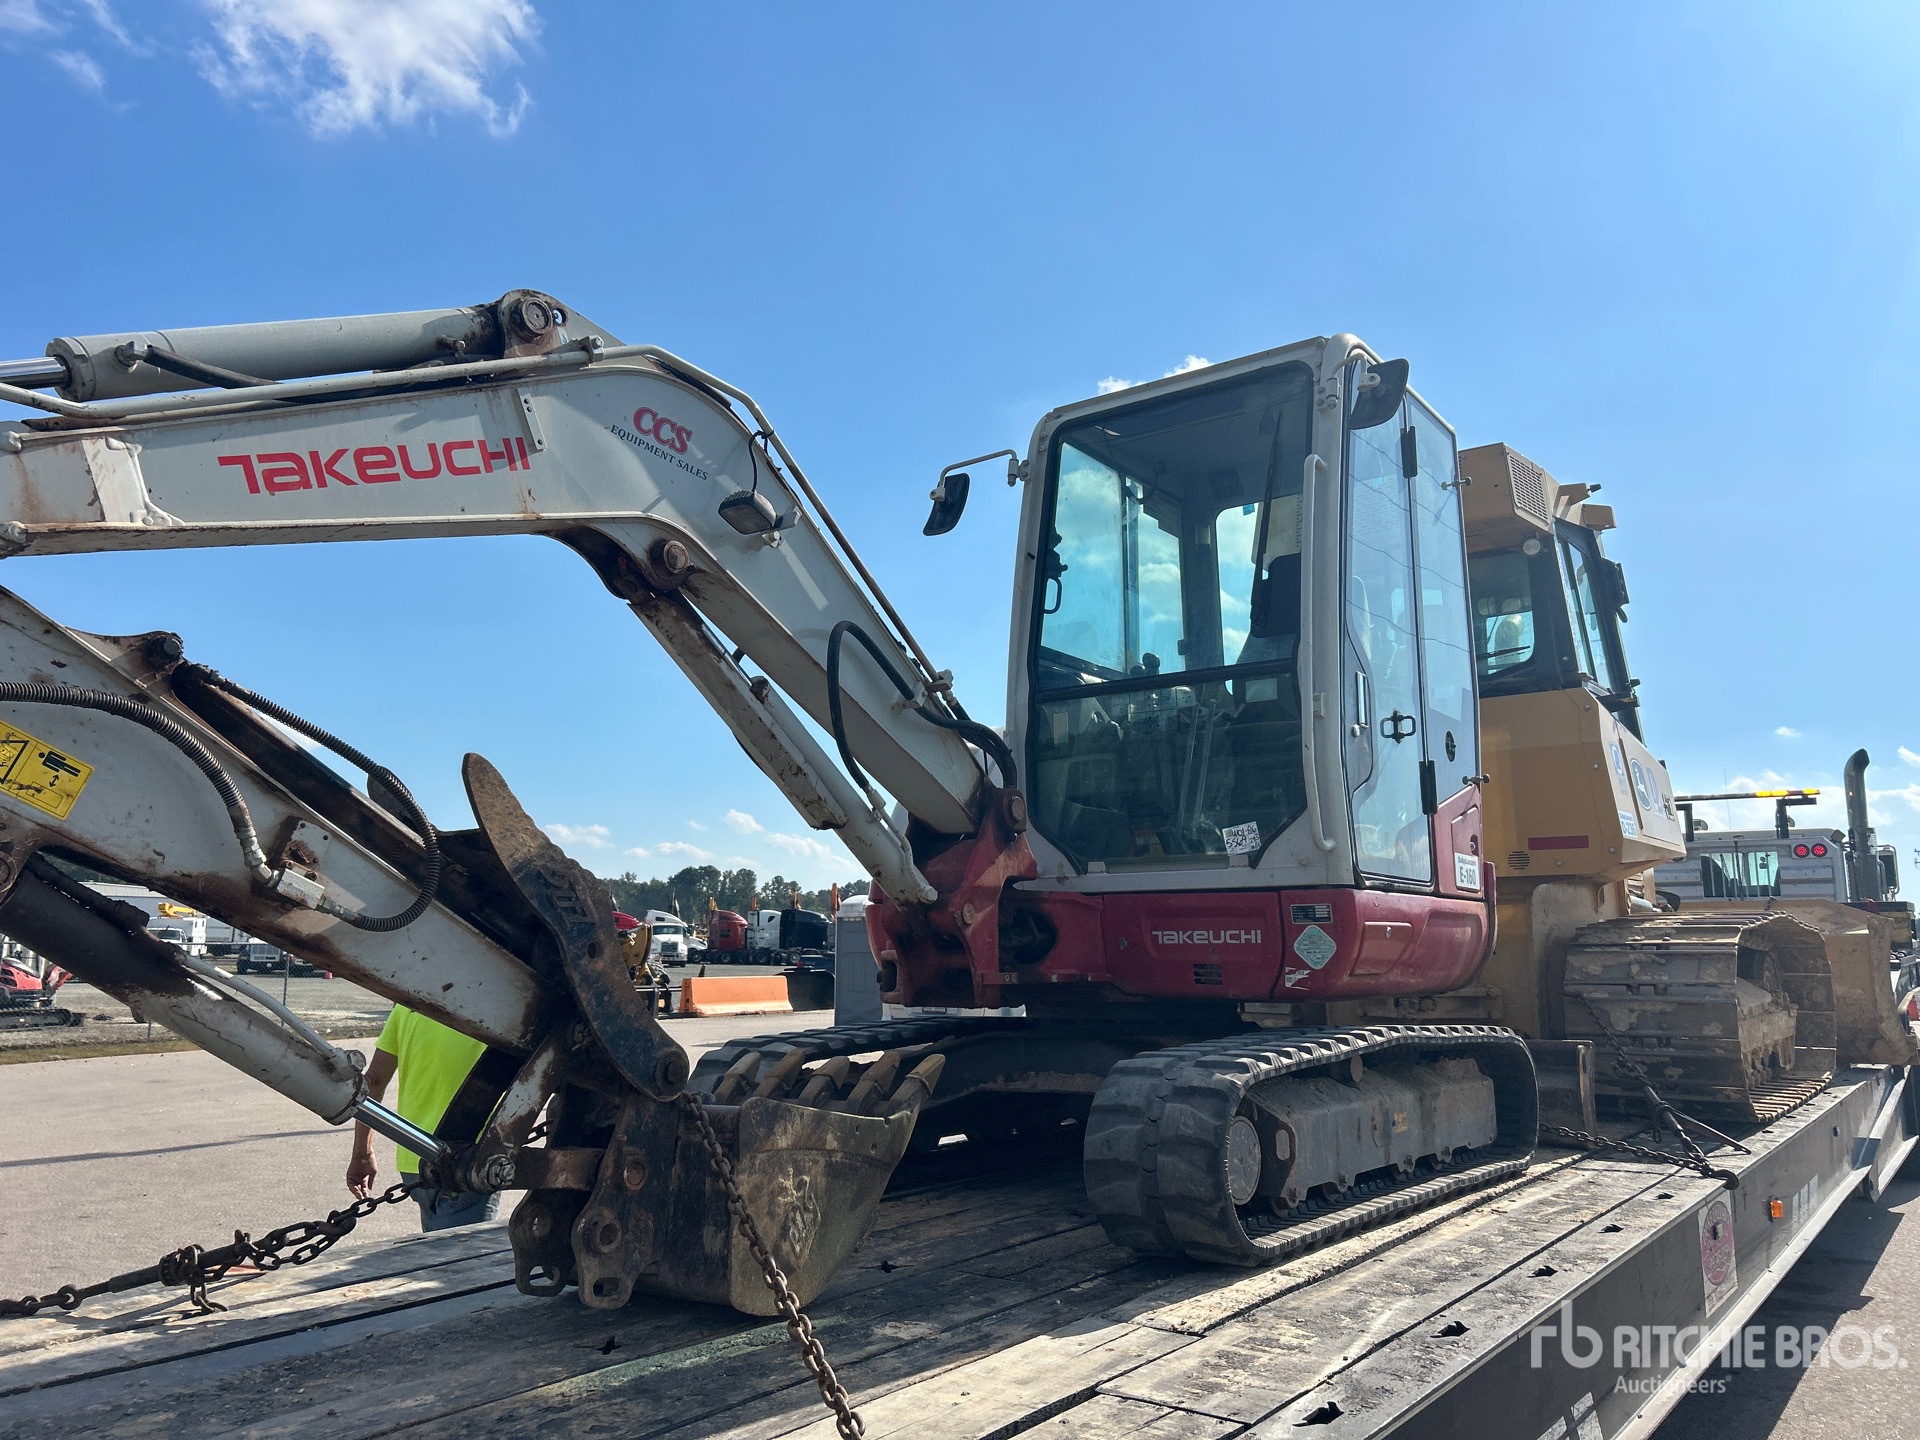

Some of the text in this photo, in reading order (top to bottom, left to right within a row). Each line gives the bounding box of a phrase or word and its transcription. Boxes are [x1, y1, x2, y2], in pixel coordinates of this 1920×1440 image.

[610, 424, 709, 480] EQUIPMENT SALES
[633, 407, 693, 455] CCS
